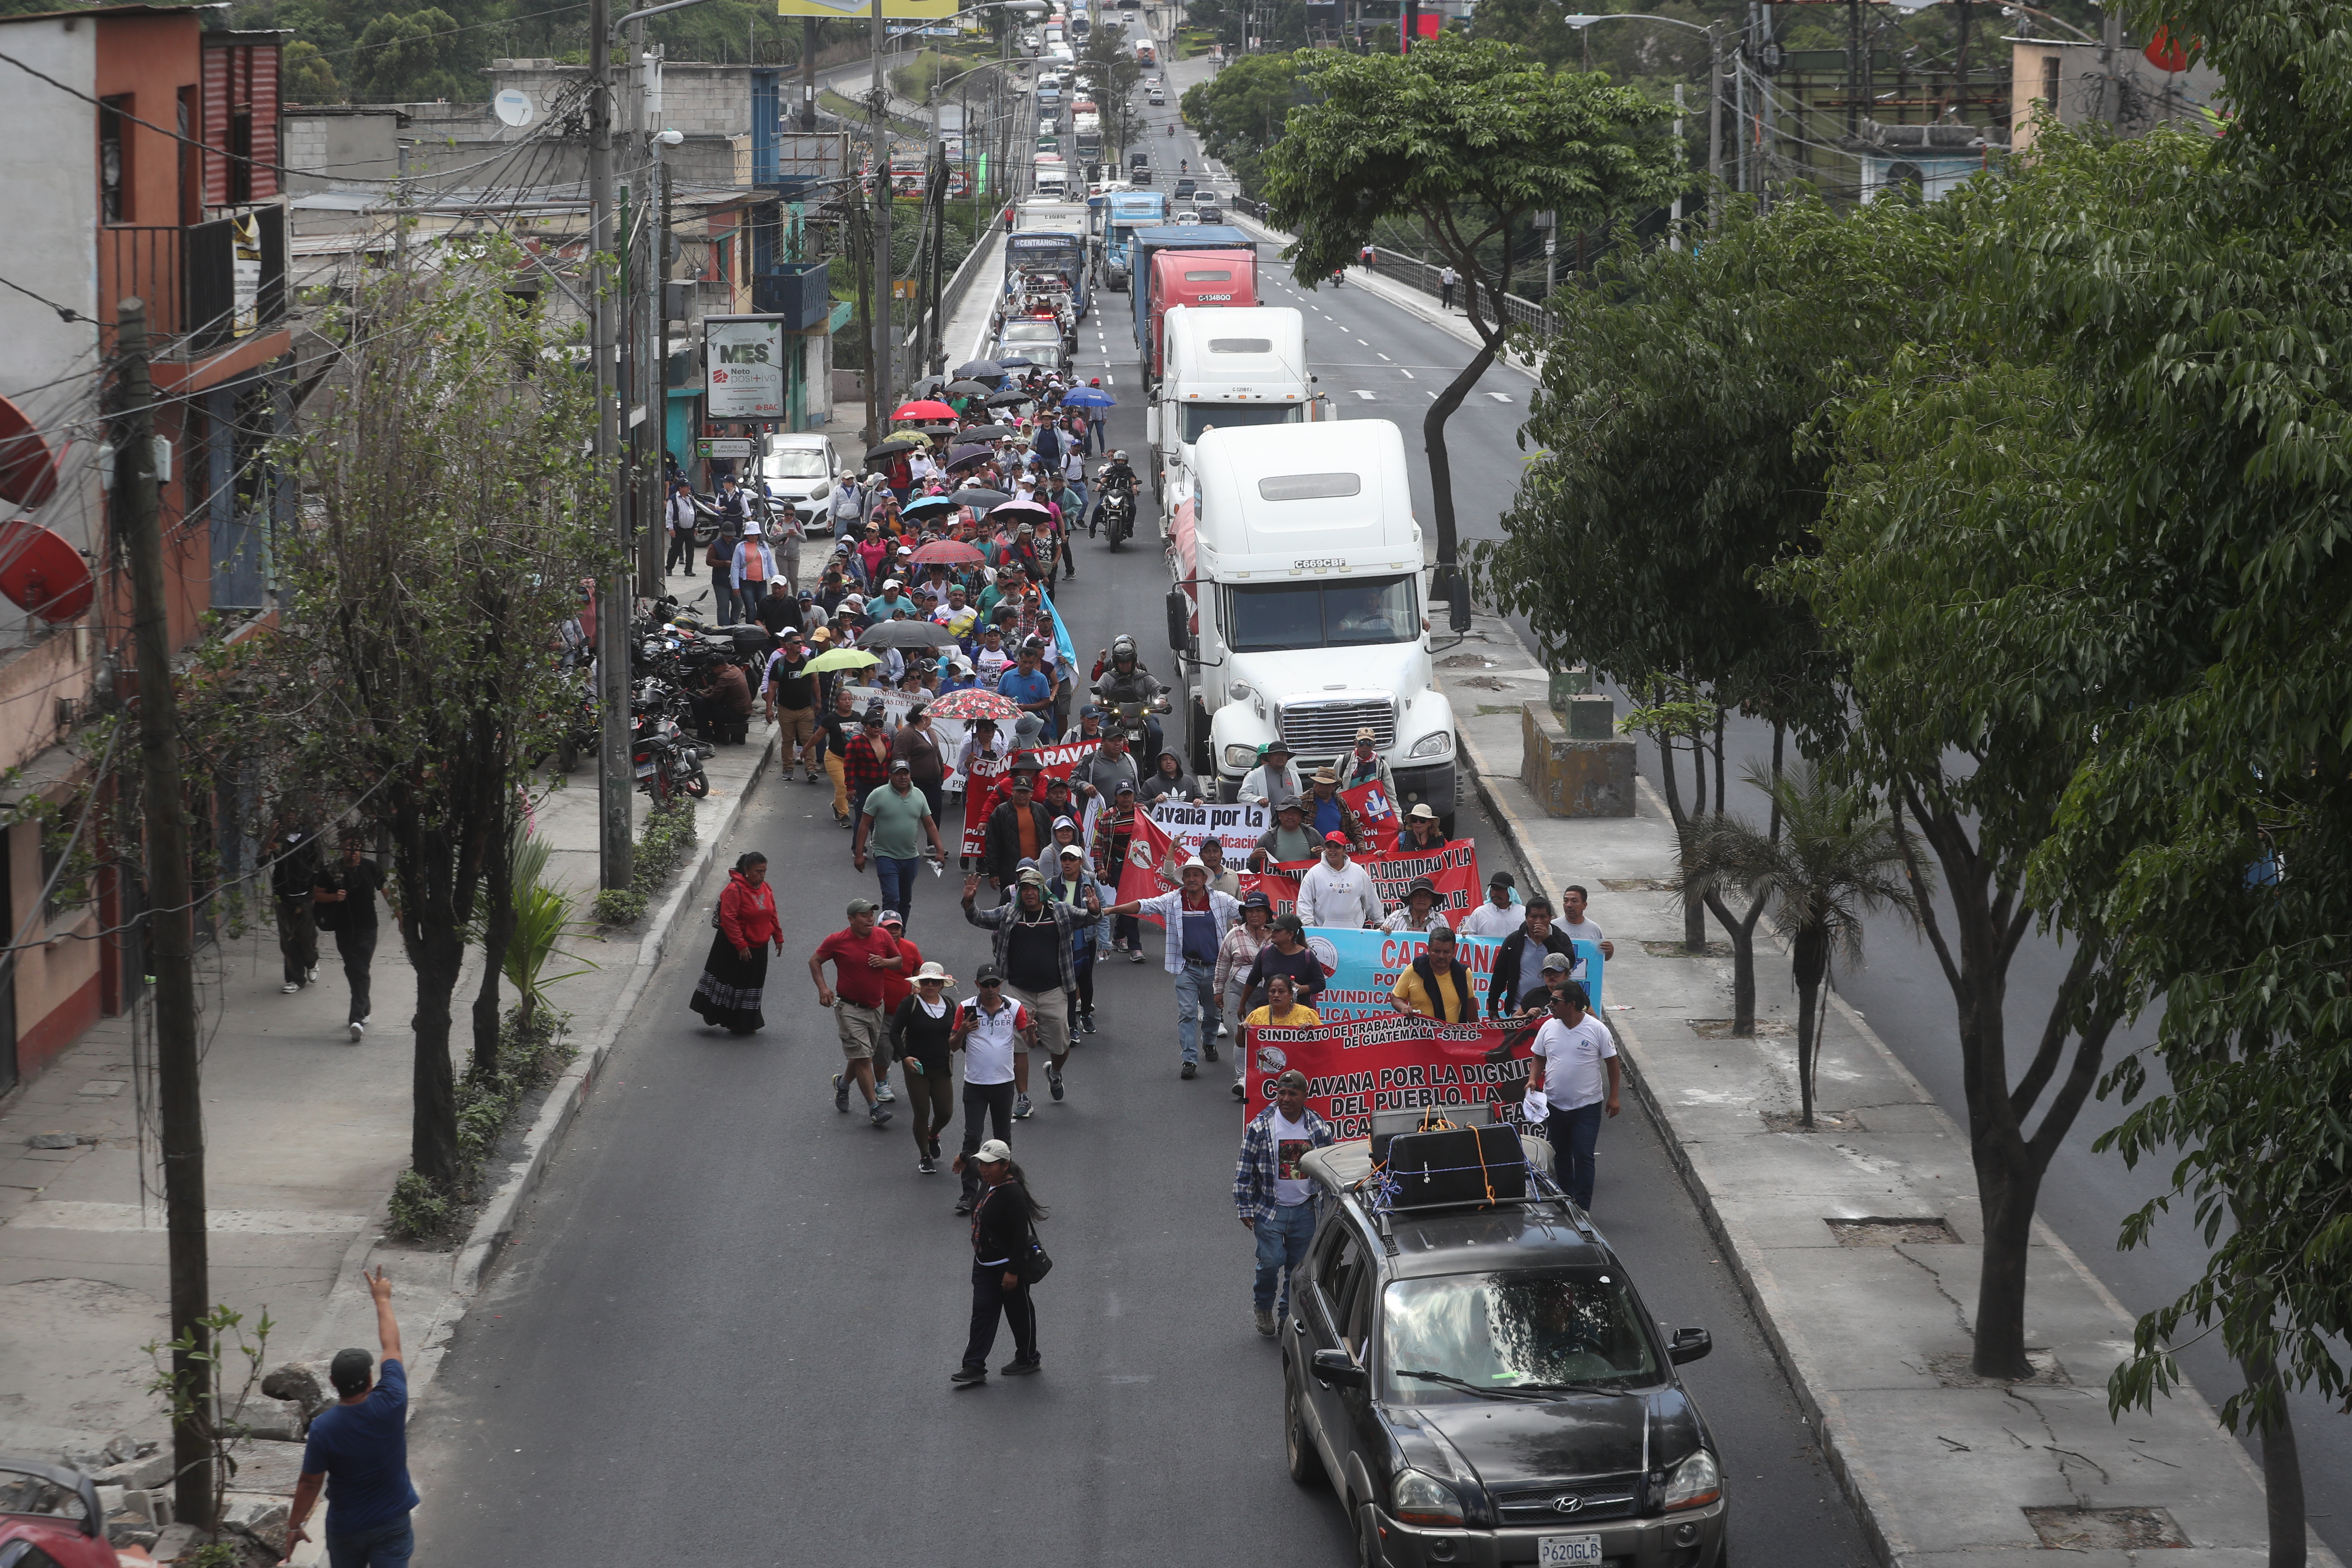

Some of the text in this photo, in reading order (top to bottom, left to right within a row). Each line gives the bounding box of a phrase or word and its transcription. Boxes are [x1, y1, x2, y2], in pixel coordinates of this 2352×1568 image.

[720, 343, 769, 364] MES
[1295, 559, 1345, 568] C669CBF
[873, 689, 910, 700] SINDICATO
[972, 755, 1013, 778] GRAN
[1210, 809, 1240, 830] por
[1245, 805, 1263, 828] la
[1371, 810, 1393, 824] ANM
[962, 842, 983, 854] EL
[1379, 854, 1443, 880] DIGNIDAD
[1442, 850, 1453, 869] Y
[1454, 847, 1472, 867] LA
[1452, 889, 1469, 910] DE
[1257, 1028, 1330, 1042] SINDICATO
[1332, 1025, 1348, 1039] DE
[1350, 1016, 1445, 1035] TRABAJADORES
[1344, 1027, 1482, 1049] DE GUATEMALA -STEG-
[1380, 1064, 1426, 1090] POR
[1430, 1064, 1460, 1085] LA
[1331, 1095, 1370, 1118] DEL
[1471, 1086, 1503, 1105] LA
